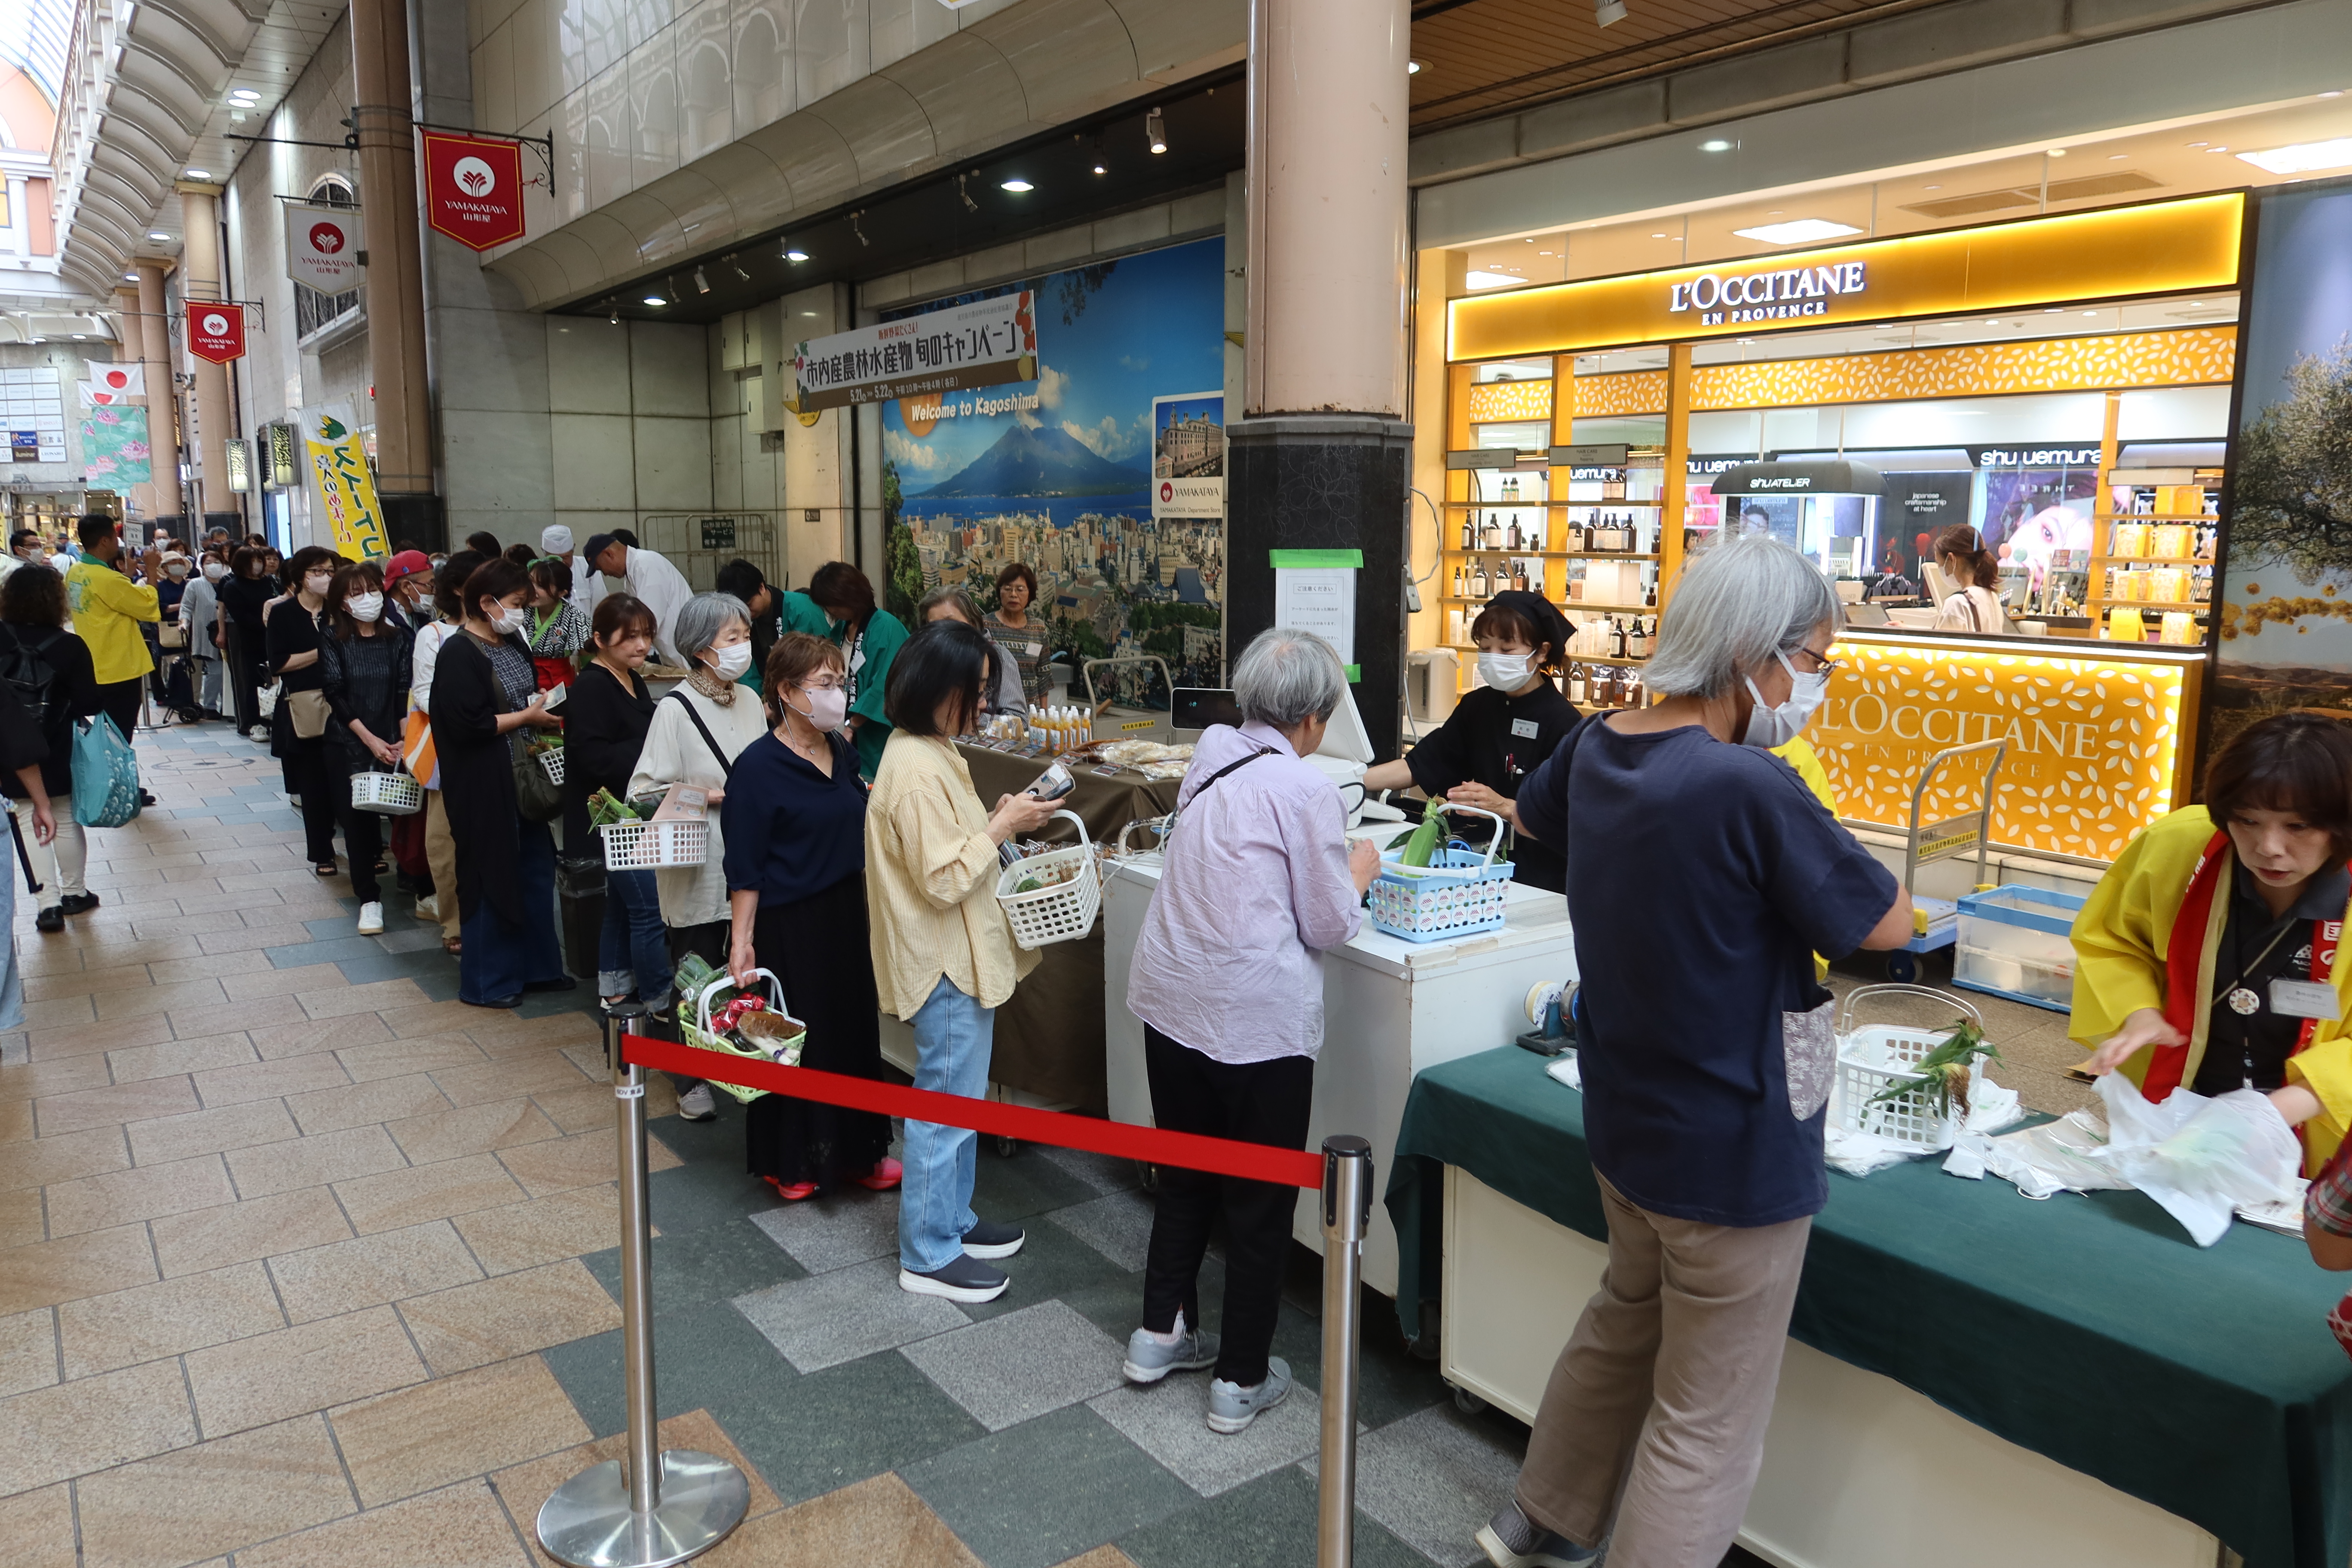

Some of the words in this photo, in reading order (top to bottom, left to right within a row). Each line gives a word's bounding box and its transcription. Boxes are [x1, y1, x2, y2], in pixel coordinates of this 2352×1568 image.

[444, 200, 508, 215] YAMAKATAYA
[463, 213, 491, 223] 山形屋
[301, 257, 355, 268] YAMAKATAYA
[1701, 312, 1726, 326] EN
[1731, 301, 1826, 323] PROVENCE
[197, 337, 235, 346] YAMAKATAYA
[806, 342, 913, 387] 市内産農林水産物
[916, 320, 1016, 367] 旬のキャンペーン
[911, 401, 956, 422] Welcome
[959, 401, 972, 416] to
[974, 392, 1039, 416] Kagoshima
[1980, 449, 2018, 466] shu
[2023, 448, 2101, 465] uemura
[1174, 487, 1219, 497] YAMAKATAYA
[1864, 744, 1890, 760] EN
